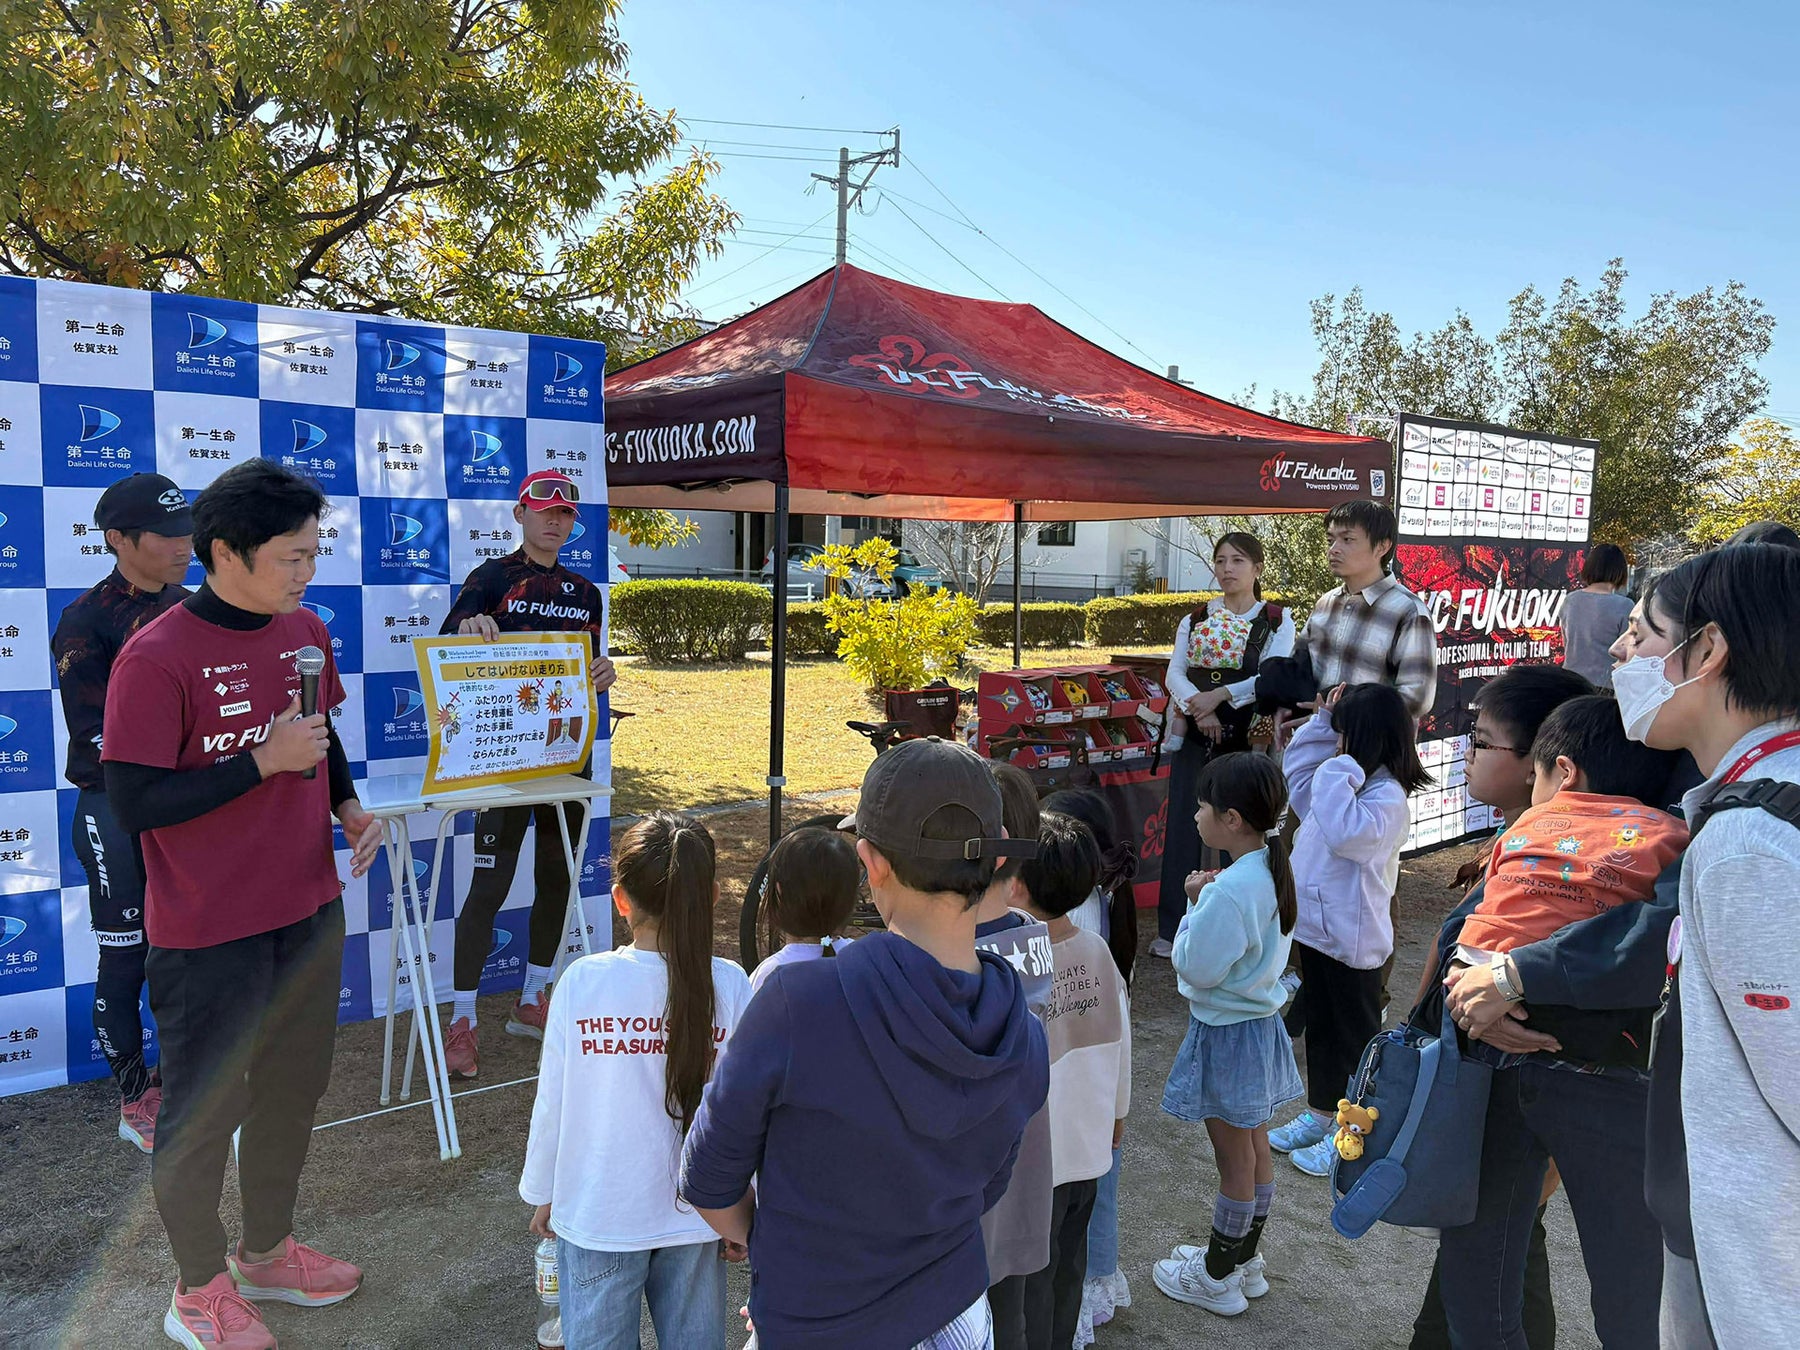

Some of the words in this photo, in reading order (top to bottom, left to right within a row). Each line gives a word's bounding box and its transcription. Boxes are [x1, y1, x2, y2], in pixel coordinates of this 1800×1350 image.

[65, 319, 125, 337] 第一生命
[73, 342, 119, 355] 佐賀支社
[283, 341, 334, 359] 第一生命
[176, 351, 236, 368] 第一生命
[176, 366, 199, 374] Daiichi
[200, 367, 213, 376] Life
[214, 369, 236, 378] Group
[290, 362, 328, 375] 佐賀支社
[466, 360, 509, 373] 第一生命
[375, 372, 426, 388] 第一生命
[470, 378, 503, 389] 佐賀支社
[543, 384, 589, 398] 第一生命
[181, 427, 236, 442] 第一生命
[605, 414, 757, 464] C-FUKUOKA.COM
[66, 445, 132, 460] 第一生命
[189, 448, 230, 460] 佐賀支社
[377, 441, 423, 455] 第一生命
[546, 449, 587, 462] 第一生命
[110, 462, 131, 470] Group
[282, 455, 336, 470] 第一生命
[384, 460, 419, 471] 佐賀支社
[1293, 457, 1358, 480] Fukuoka
[317, 469, 336, 478] Group
[462, 465, 510, 477] 第一生命
[1305, 482, 1331, 490] Powered
[1331, 483, 1339, 491] by
[1339, 483, 1359, 491] KYUSHU
[470, 530, 512, 542] 第一生命
[381, 549, 430, 560] 第一生命
[560, 550, 592, 560] 一生命
[507, 600, 527, 613] VC
[530, 599, 590, 623] FUKUOKA
[384, 615, 430, 627] 第一生命
[1436, 643, 1491, 665] ROFESSIONAL
[1494, 642, 1526, 660] CYCLING
[1529, 641, 1550, 657] TEAM
[465, 664, 565, 678] してはいけない走り方
[475, 694, 513, 705] ふたりのり
[223, 703, 248, 714] youme
[475, 707, 513, 719] よそ見運転
[475, 721, 513, 733] かた手運転
[203, 733, 235, 753] VC
[475, 731, 545, 747] ライトをつけずに走る
[472, 747, 517, 759] ならんで走る
[4, 765, 29, 773] Group
[1514, 876, 1535, 886] CAN
[1538, 880, 1555, 889] DO
[98, 932, 139, 944] youme
[15, 966, 38, 974] Group
[1052, 965, 1086, 984] LWAYS
[1064, 982, 1075, 995] TO
[1079, 980, 1090, 990] BE
[1094, 976, 1101, 987] A
[576, 1017, 613, 1035] THE
[617, 1017, 661, 1033] YOU
[581, 1039, 668, 1055] PLEASUR
